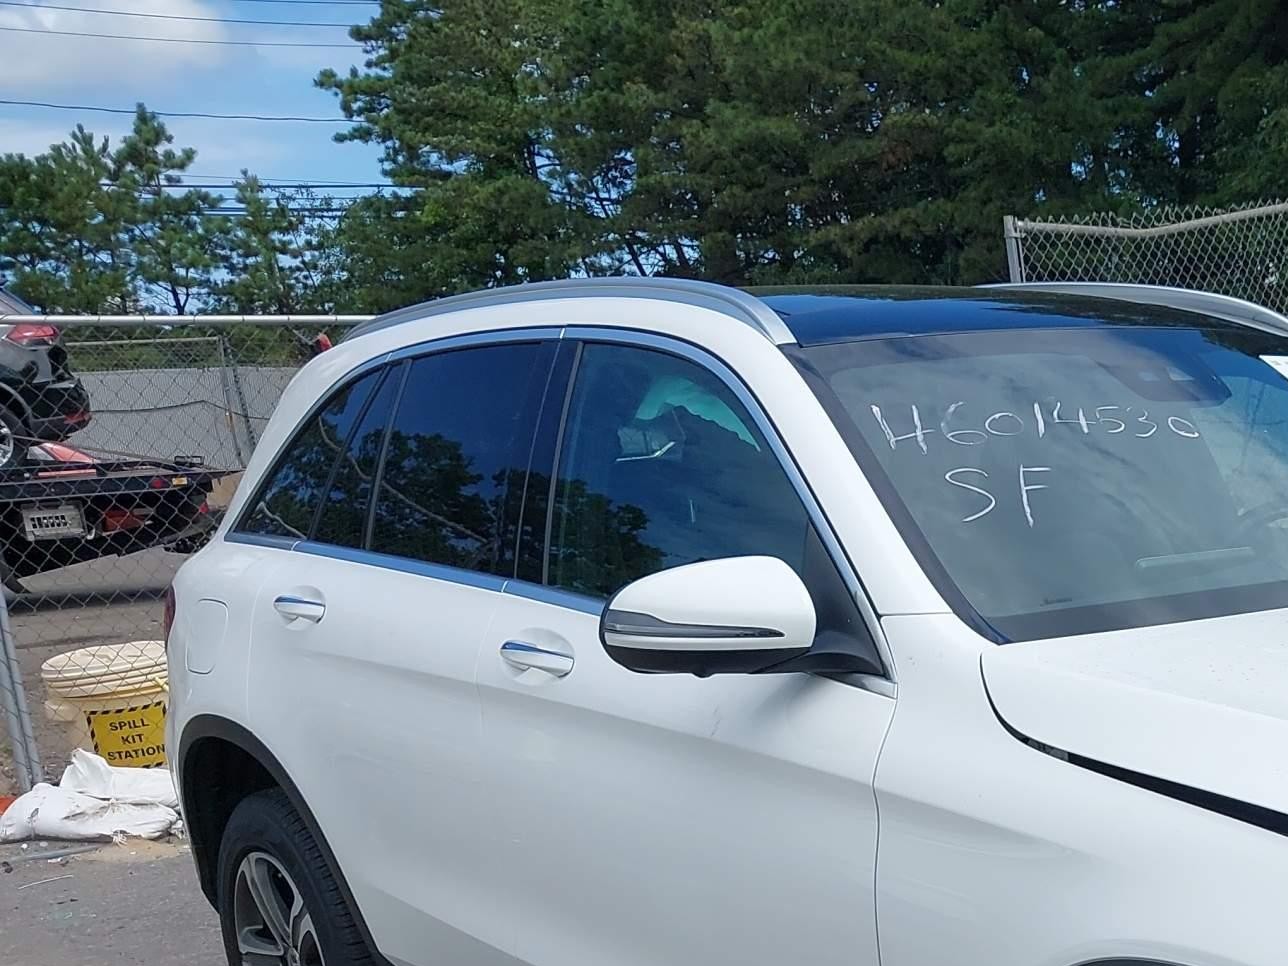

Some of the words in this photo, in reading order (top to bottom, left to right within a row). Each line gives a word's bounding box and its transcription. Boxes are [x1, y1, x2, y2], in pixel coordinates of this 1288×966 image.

[870, 401, 1200, 455] 46014530
[109, 718, 149, 731] SPILL
[121, 733, 144, 744] KIT
[107, 744, 165, 760] STATION
